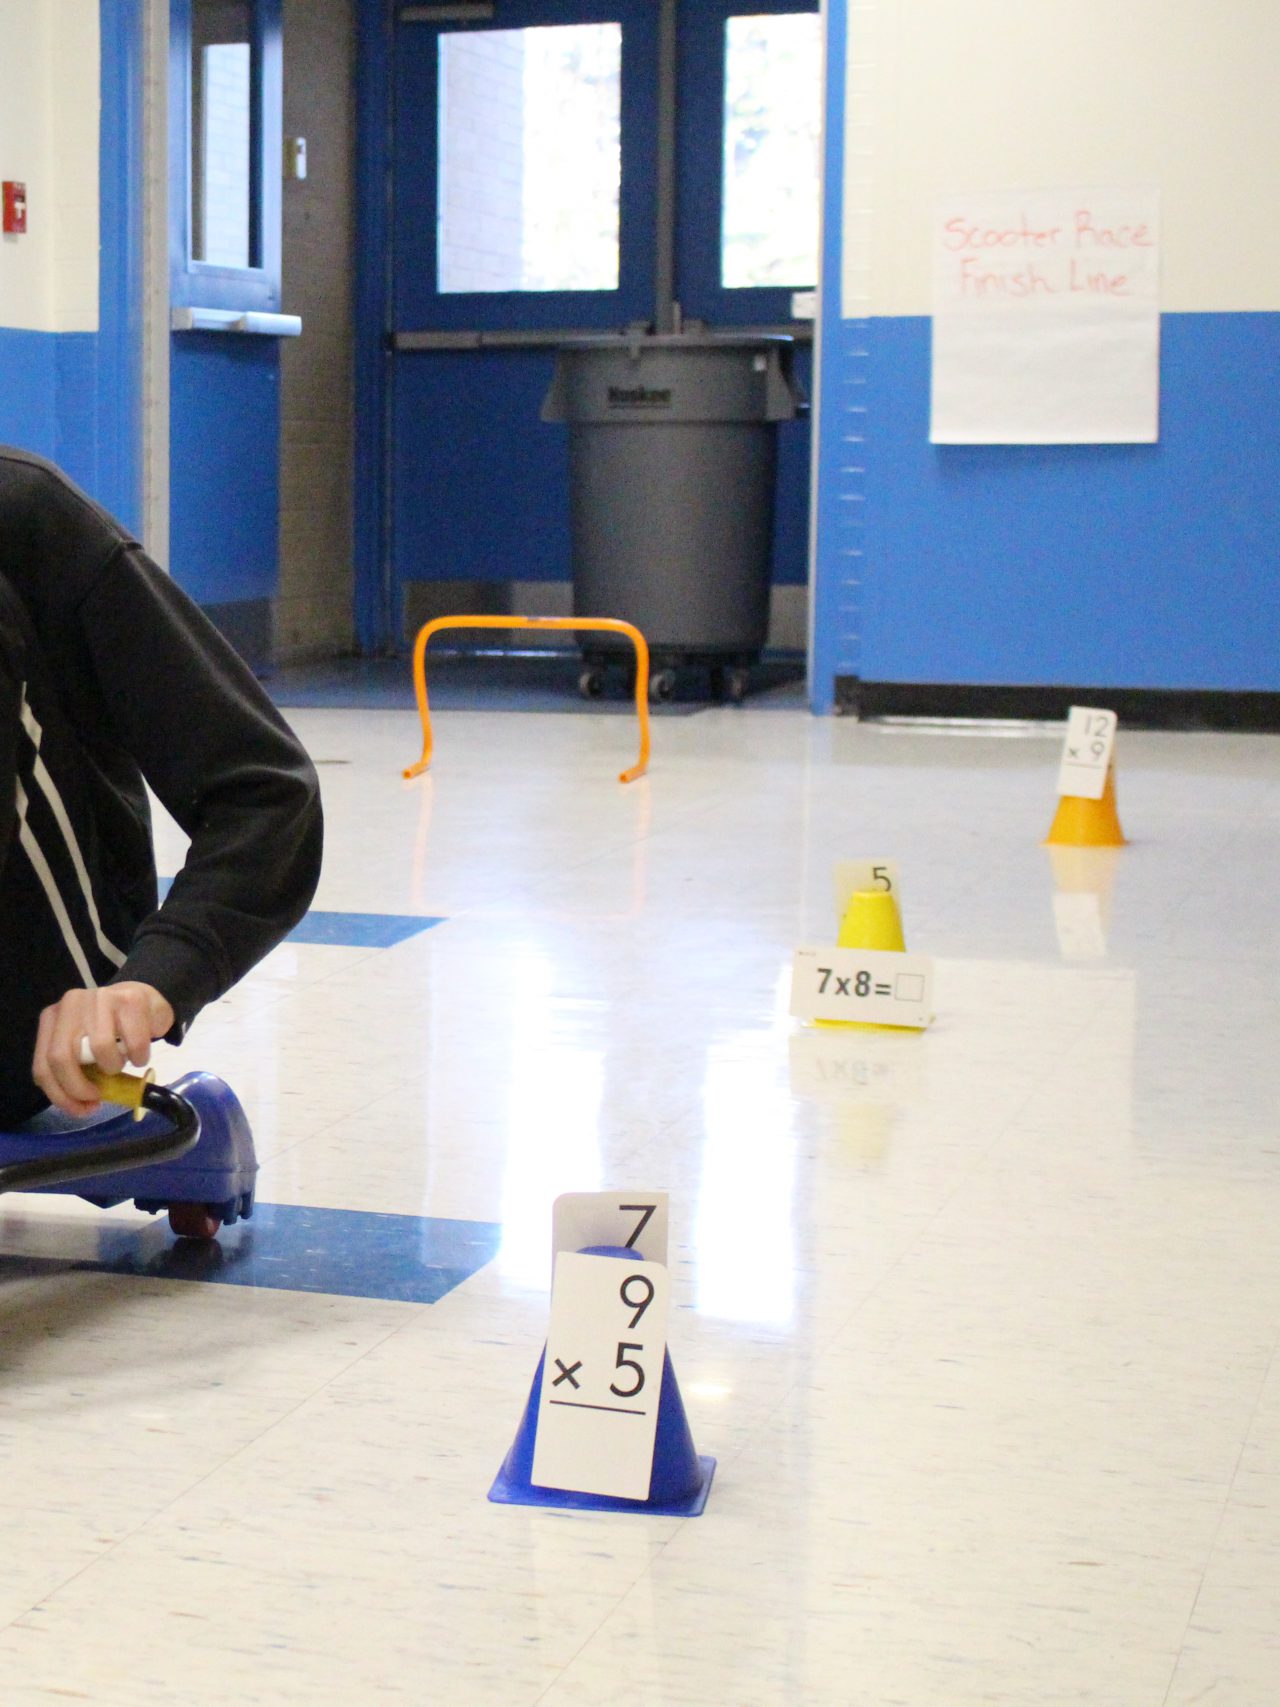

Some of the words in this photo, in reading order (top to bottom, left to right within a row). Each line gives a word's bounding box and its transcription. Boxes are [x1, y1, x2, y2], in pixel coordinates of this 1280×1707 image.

[942, 211, 1063, 252] Scooter
[1074, 209, 1154, 251] Race
[960, 256, 1059, 298] Finish
[1070, 257, 1136, 298] Line
[1084, 713, 1108, 738] 12
[1090, 741, 1106, 761] 9
[872, 866, 892, 892] 5
[618, 1204, 657, 1249] 7
[619, 1274, 655, 1329] 9
[609, 1341, 646, 1398] 5
